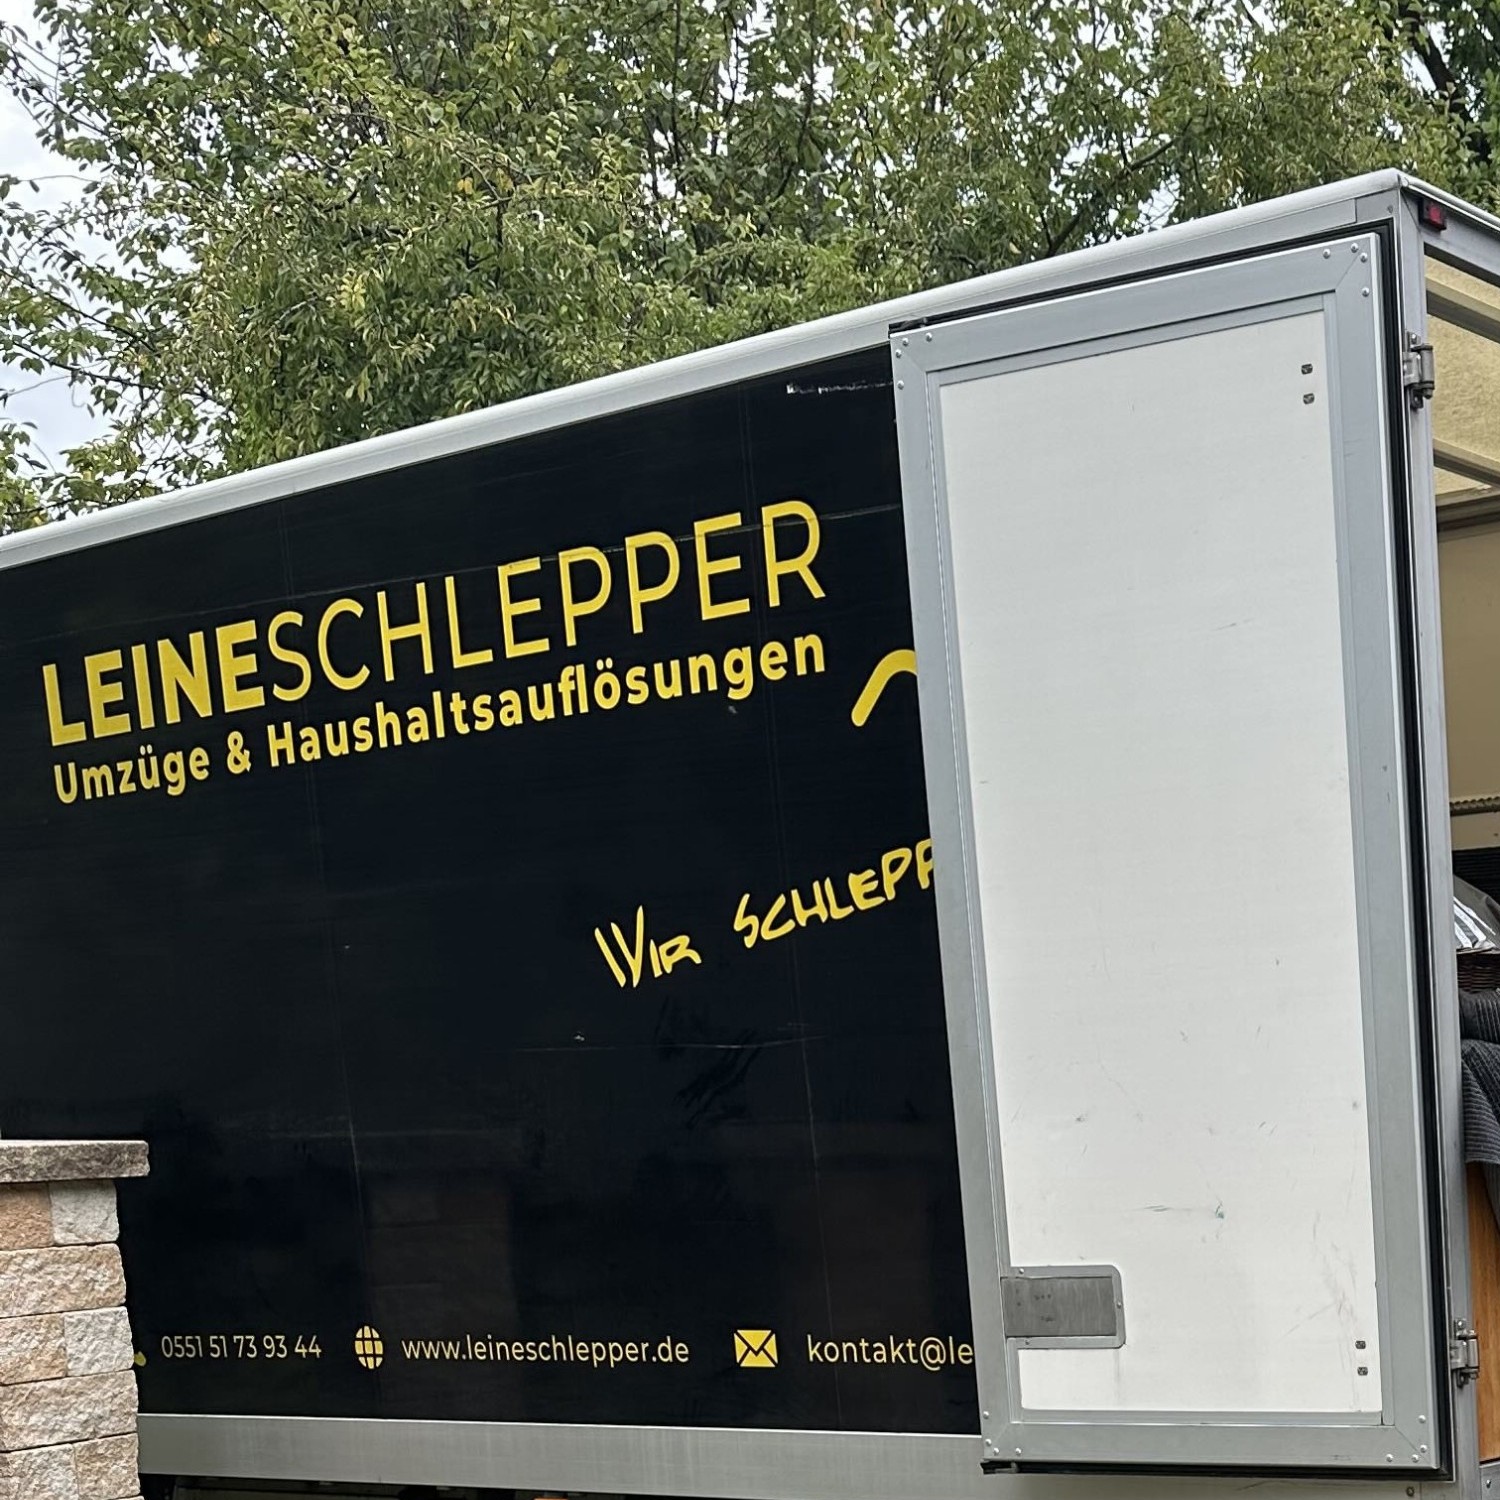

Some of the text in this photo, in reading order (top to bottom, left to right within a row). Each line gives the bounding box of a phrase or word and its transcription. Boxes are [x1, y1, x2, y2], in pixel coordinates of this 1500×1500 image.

[42, 500, 825, 747] LEINESCHLEPPER
[54, 633, 826, 804] Umzüge & Haushaltsauflösungen
[161, 1334, 322, 1359] 0551 51 73 93 44
[401, 1334, 690, 1368] www.leineschlepper.de
[807, 1333, 974, 1372] kontakt@le
